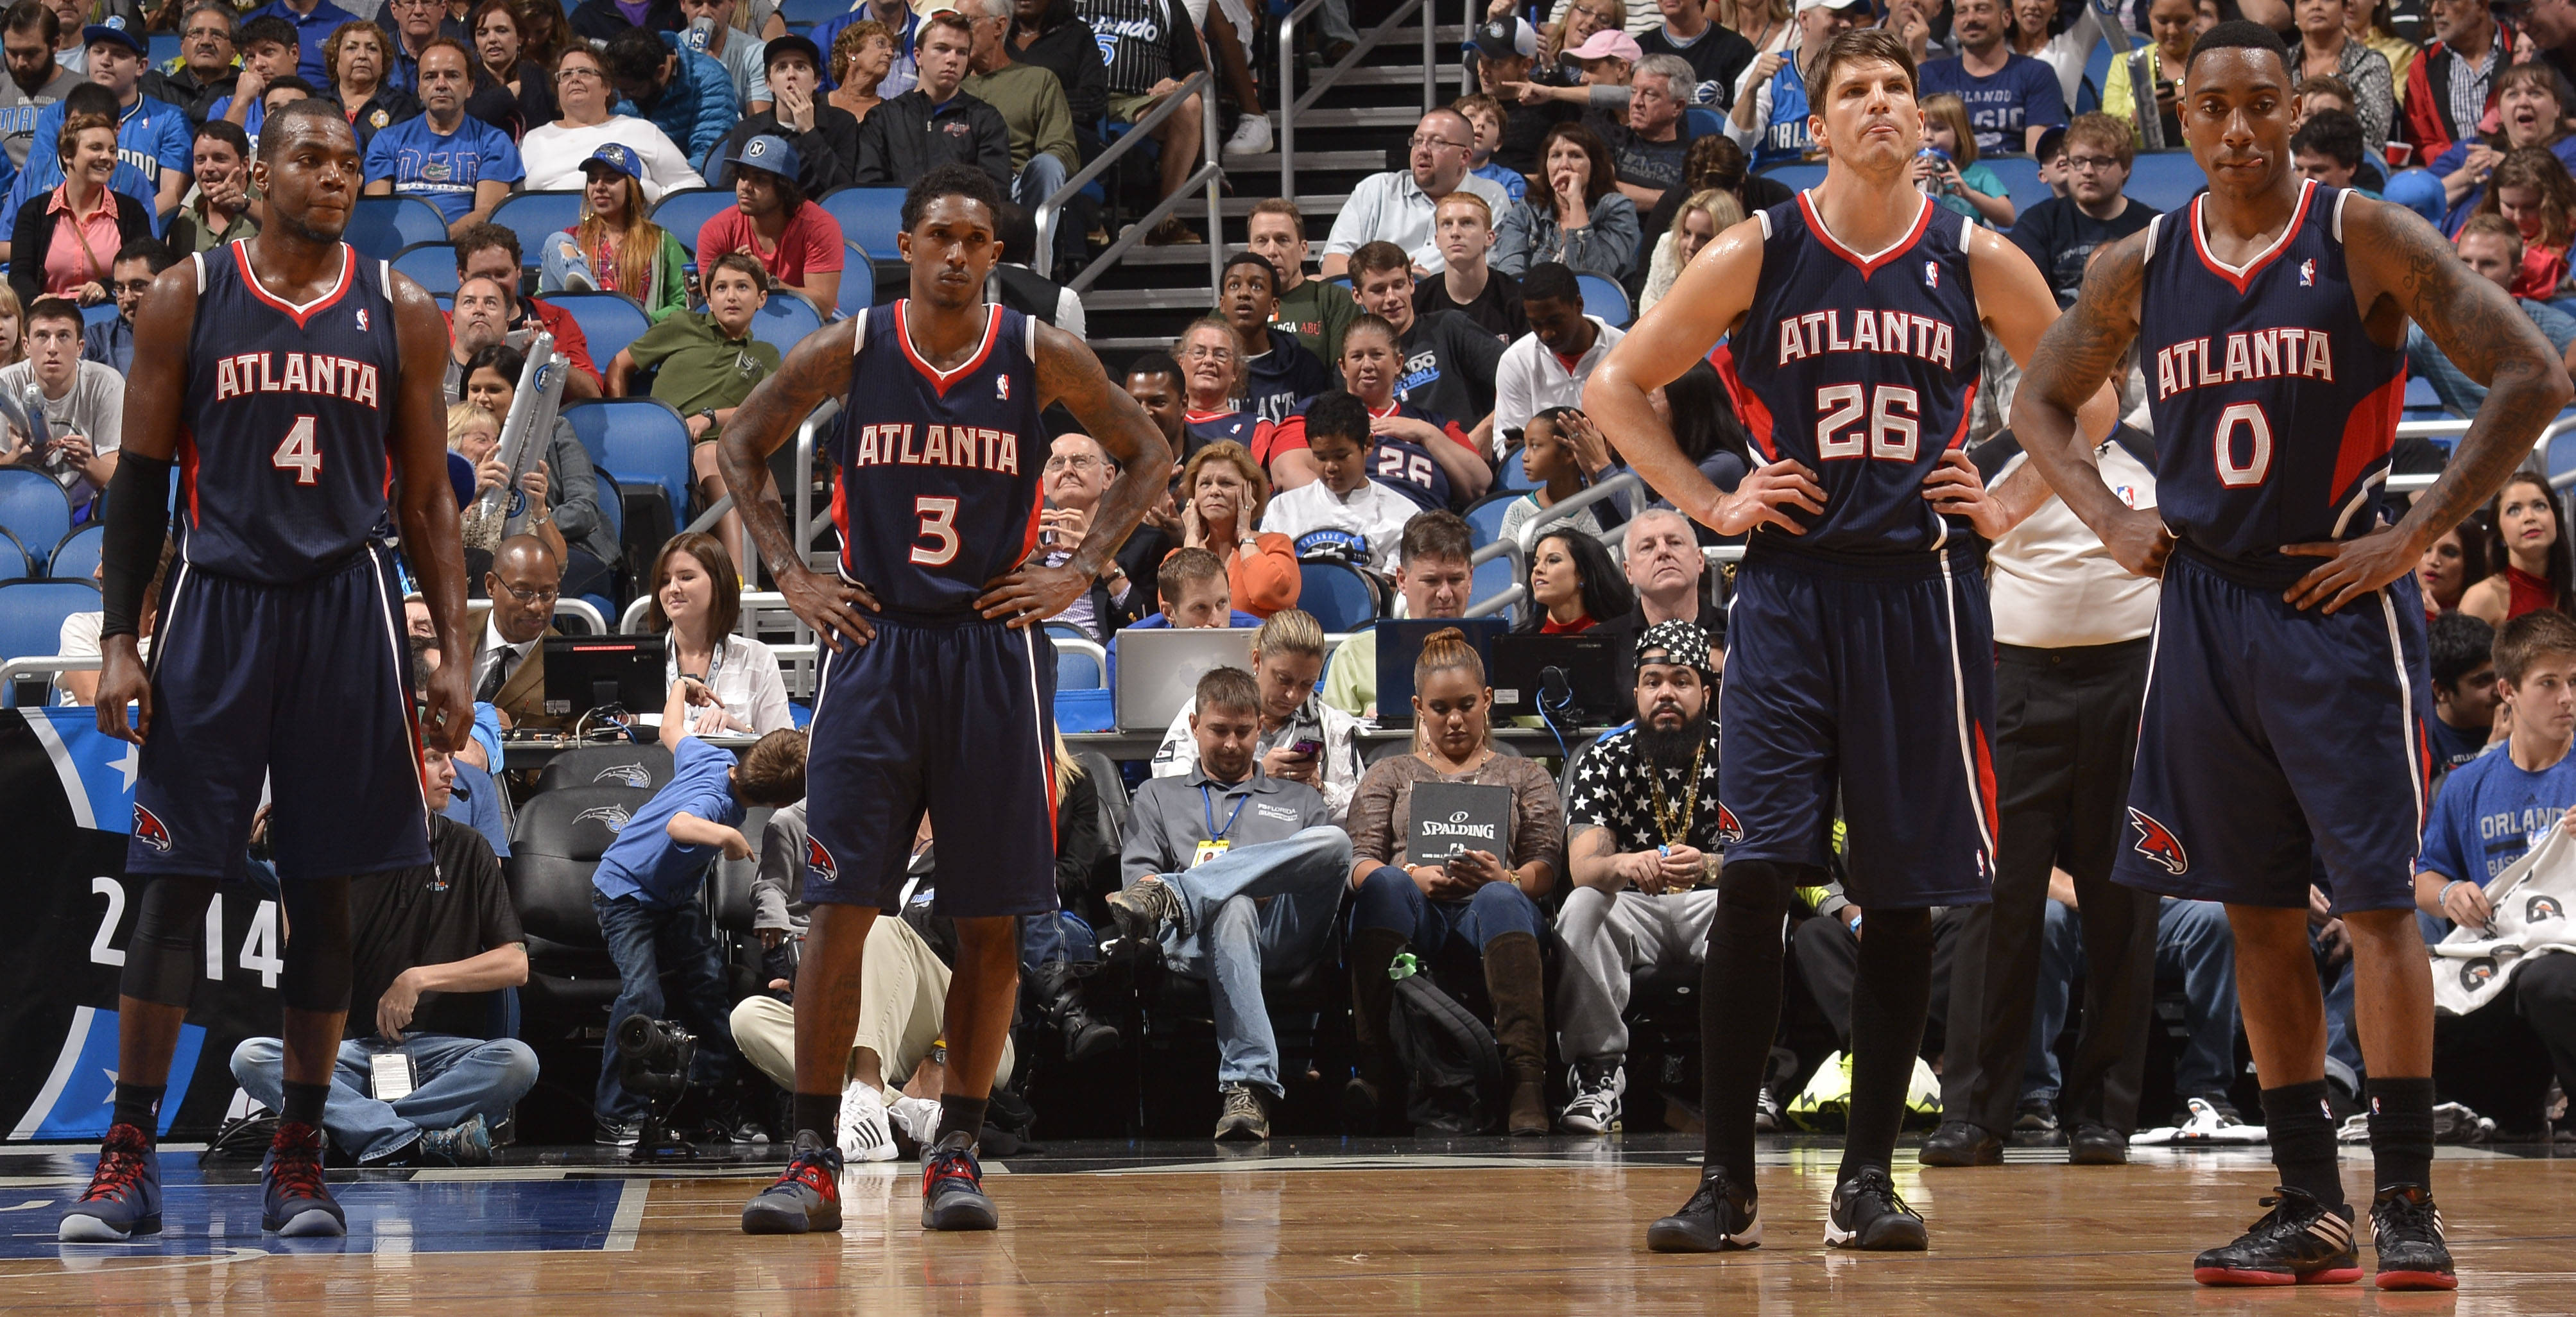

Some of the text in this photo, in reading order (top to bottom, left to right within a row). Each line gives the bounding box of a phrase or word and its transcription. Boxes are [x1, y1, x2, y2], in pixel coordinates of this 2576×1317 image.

[18, 96, 56, 105] ORANDO
[1955, 89, 2012, 103] RLANDO
[1974, 107, 2025, 131] GIC
[1778, 309, 1955, 371] ATLANTA
[2158, 327, 2335, 402] ATLANTA
[216, 351, 379, 410] ATLANTA
[271, 414, 323, 486] 4
[857, 423, 1018, 476] ATLANTA
[1816, 383, 1919, 461] 26
[2213, 400, 2274, 489] 0
[1378, 445, 1432, 490] 26
[909, 495, 960, 568] 3
[1422, 821, 1495, 839] SPALDING
[2480, 807, 2566, 839] ORLAND
[90, 876, 284, 989] 214
